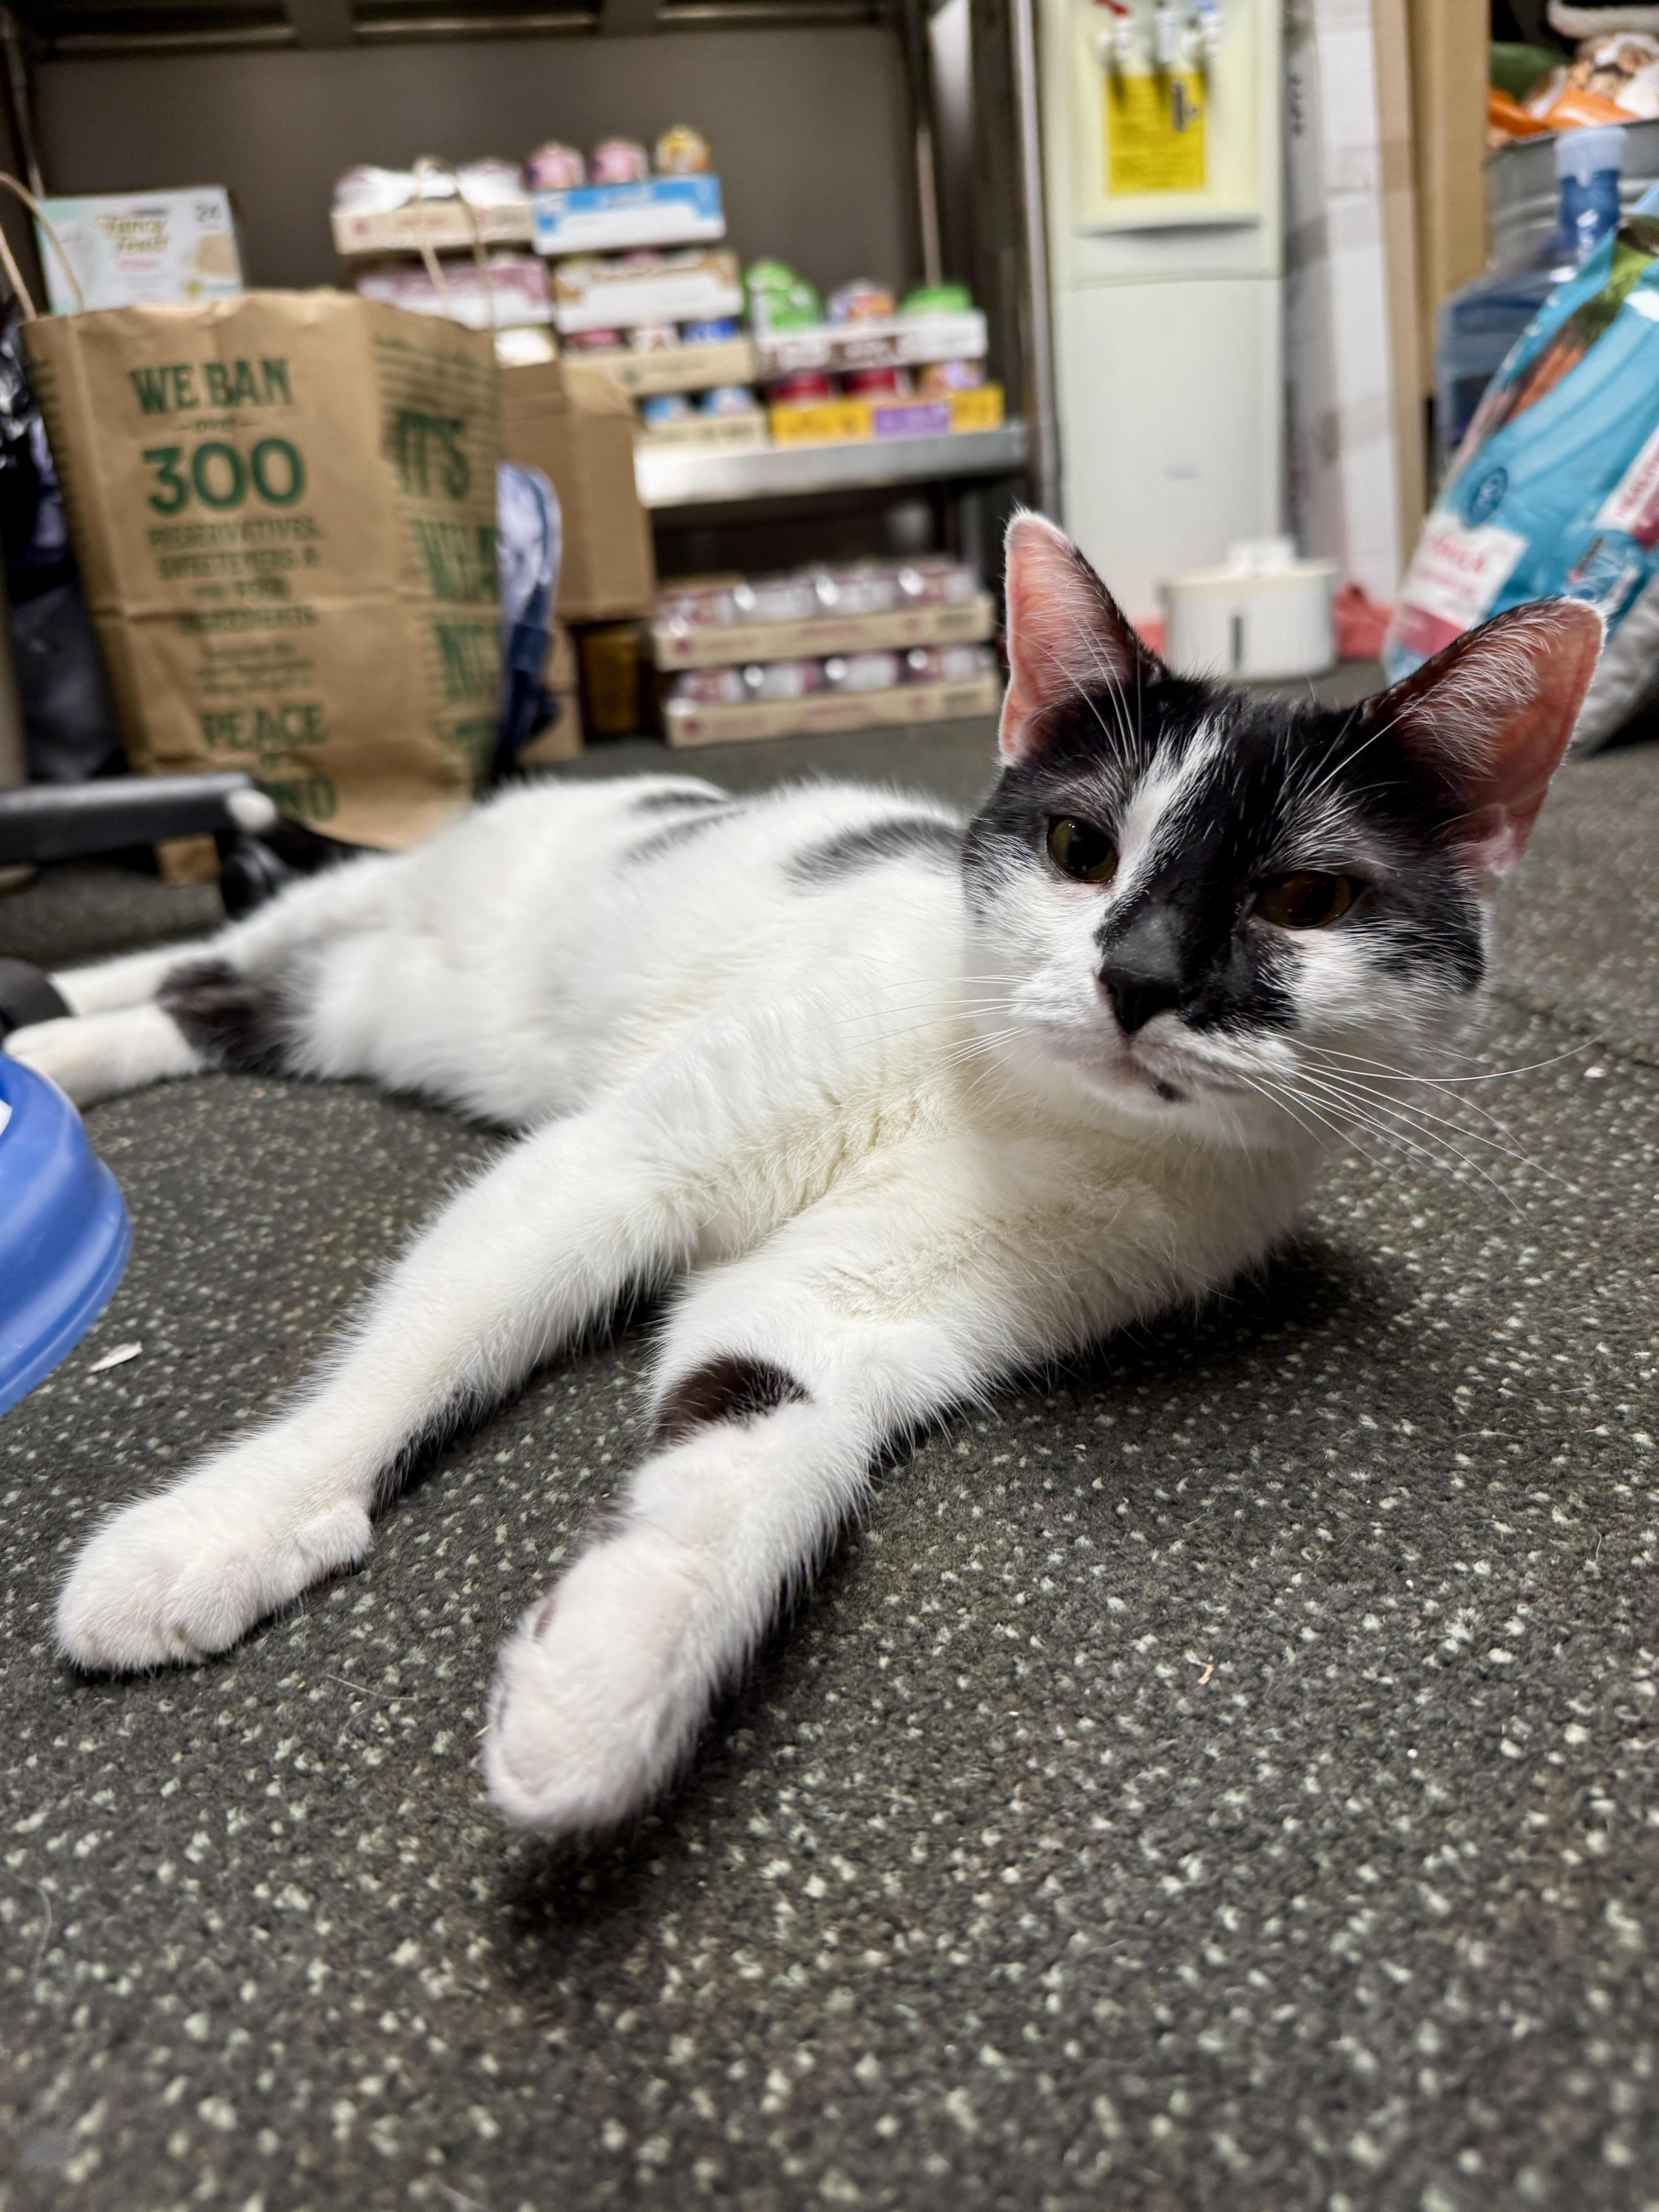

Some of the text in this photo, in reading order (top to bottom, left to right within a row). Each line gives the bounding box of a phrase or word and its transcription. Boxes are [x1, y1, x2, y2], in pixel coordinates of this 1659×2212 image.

[129, 359, 294, 414] WE BAN
[143, 438, 305, 517] 300
